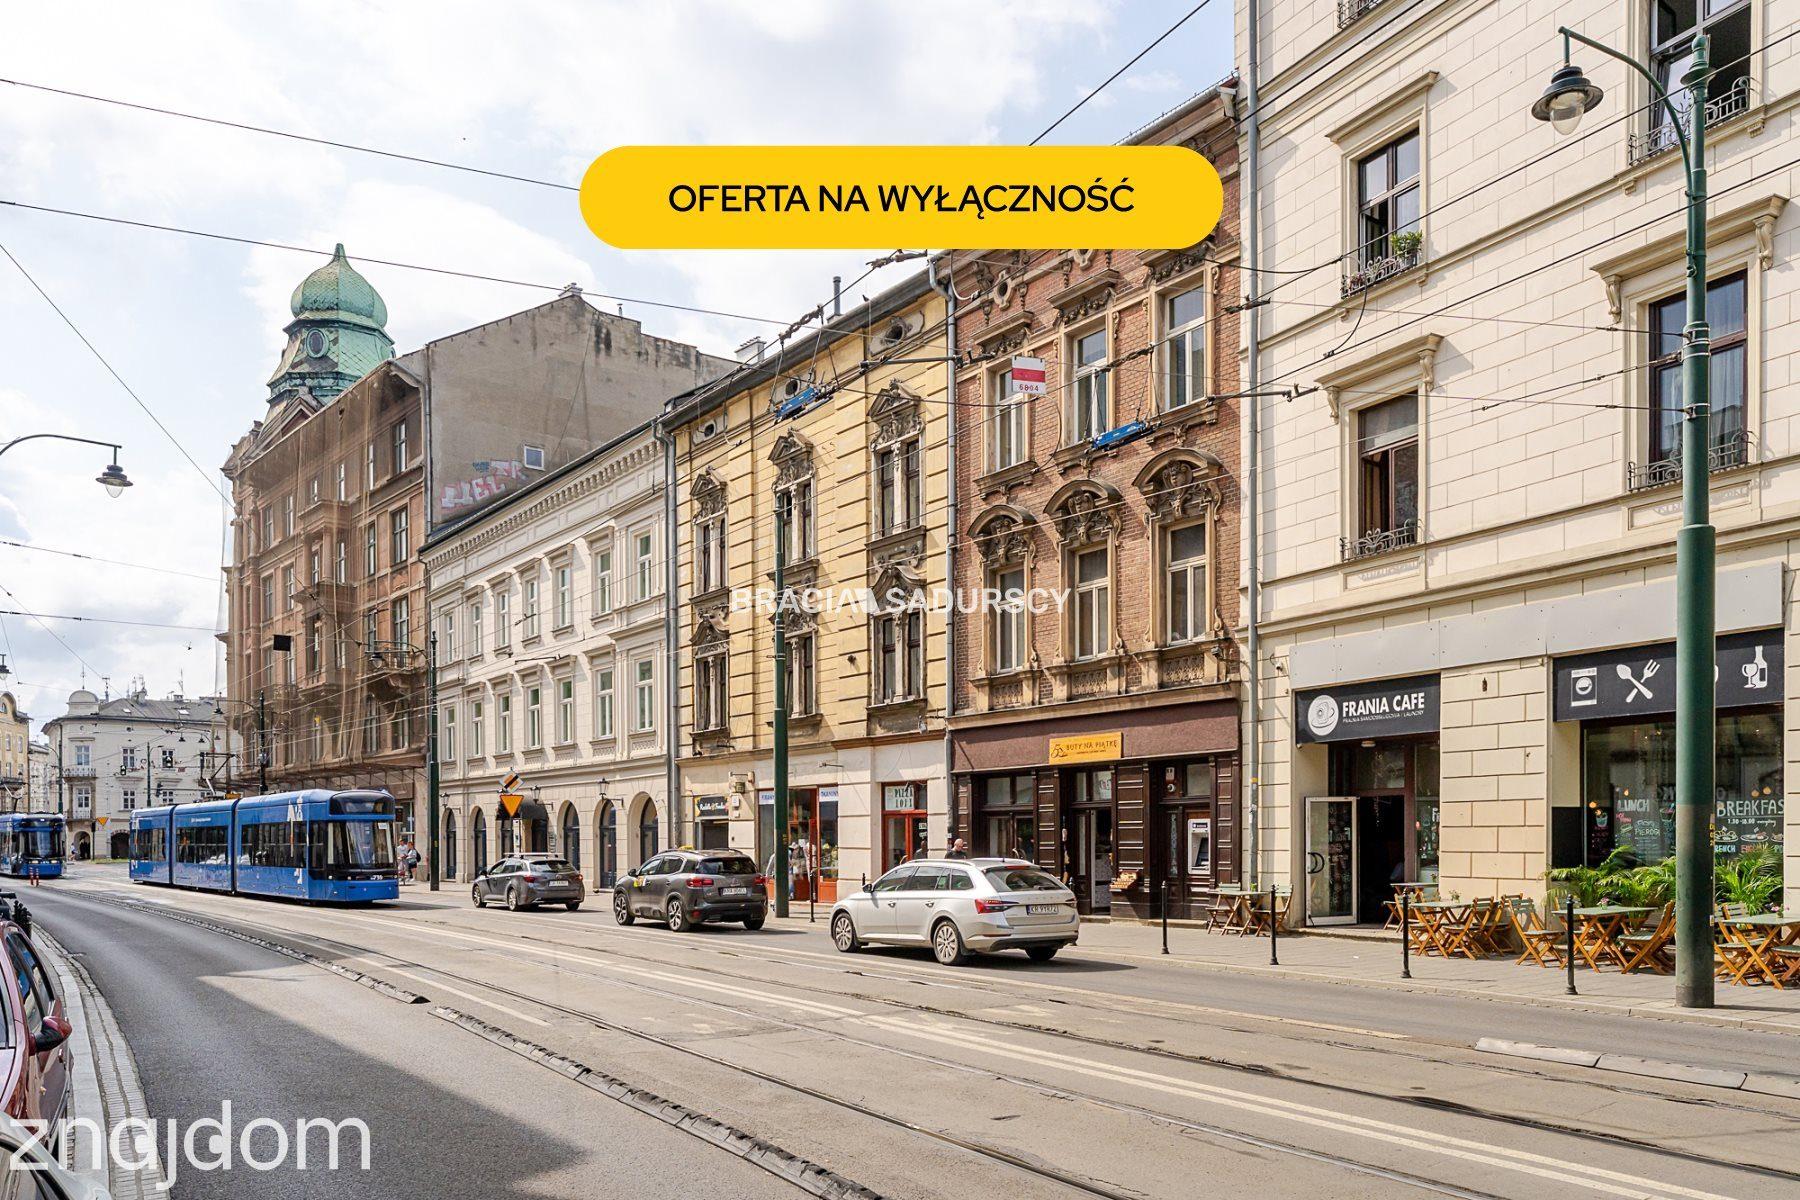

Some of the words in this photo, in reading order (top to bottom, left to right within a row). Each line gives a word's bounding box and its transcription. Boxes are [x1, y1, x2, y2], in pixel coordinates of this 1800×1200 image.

[1342, 697, 1390, 718] FRANIA
[1392, 692, 1425, 712] CAFE
[1084, 741, 1093, 749] NA
[1616, 799, 1650, 812] LUNCH
[1714, 845, 1736, 853] RENCH
